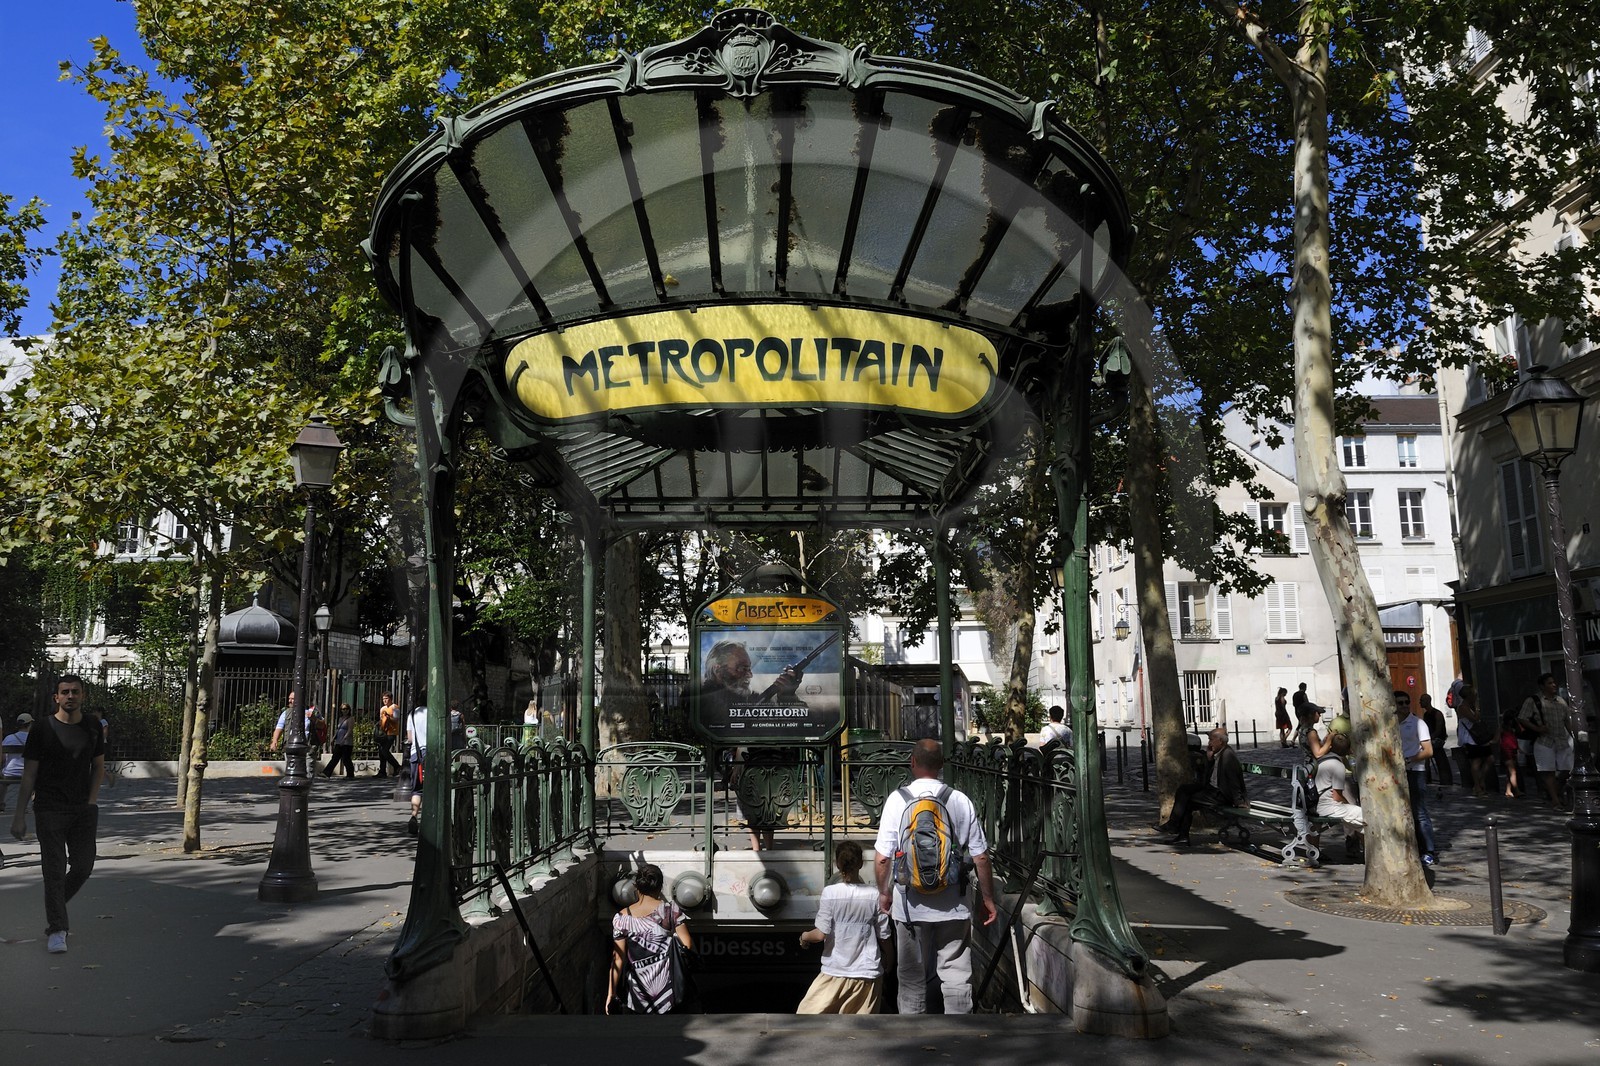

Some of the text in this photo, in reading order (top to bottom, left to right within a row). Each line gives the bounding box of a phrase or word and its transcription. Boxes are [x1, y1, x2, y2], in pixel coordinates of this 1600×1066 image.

[562, 337, 943, 396] METROPOLITAIN
[736, 601, 806, 620] ABBESSES
[1398, 633, 1415, 642] FILS
[729, 708, 809, 717] BLACKTHORN
